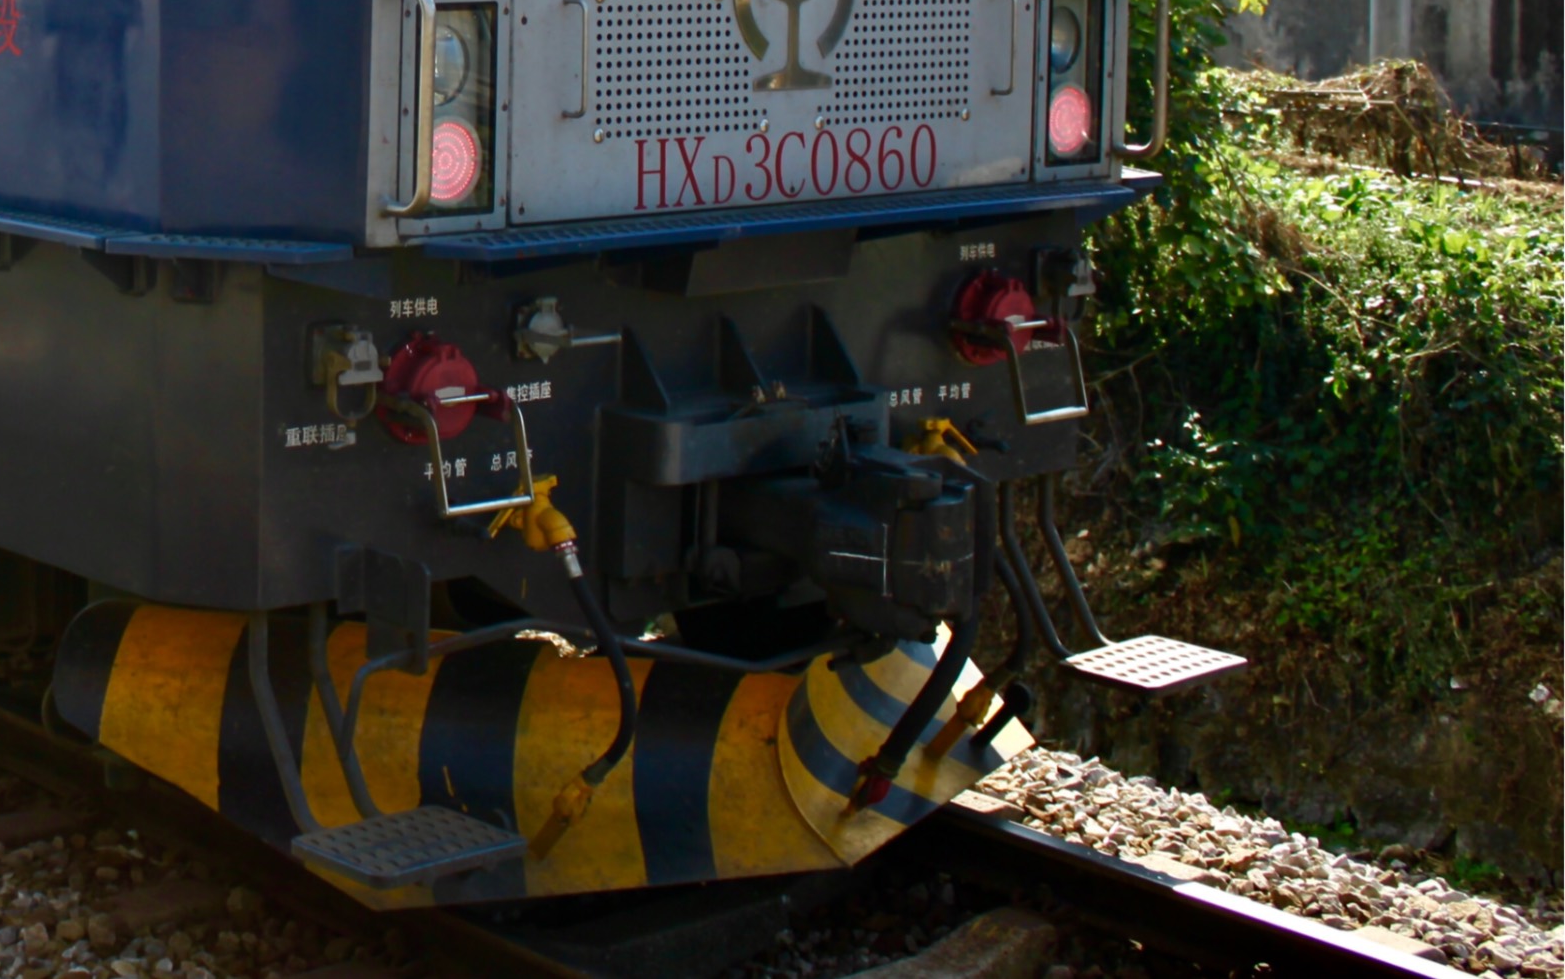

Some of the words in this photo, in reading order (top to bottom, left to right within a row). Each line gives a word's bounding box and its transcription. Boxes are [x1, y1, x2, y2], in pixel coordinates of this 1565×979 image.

[634, 124, 936, 211] HXD3C0860
[390, 297, 438, 318] 列车供电
[938, 382, 971, 401] 平均管
